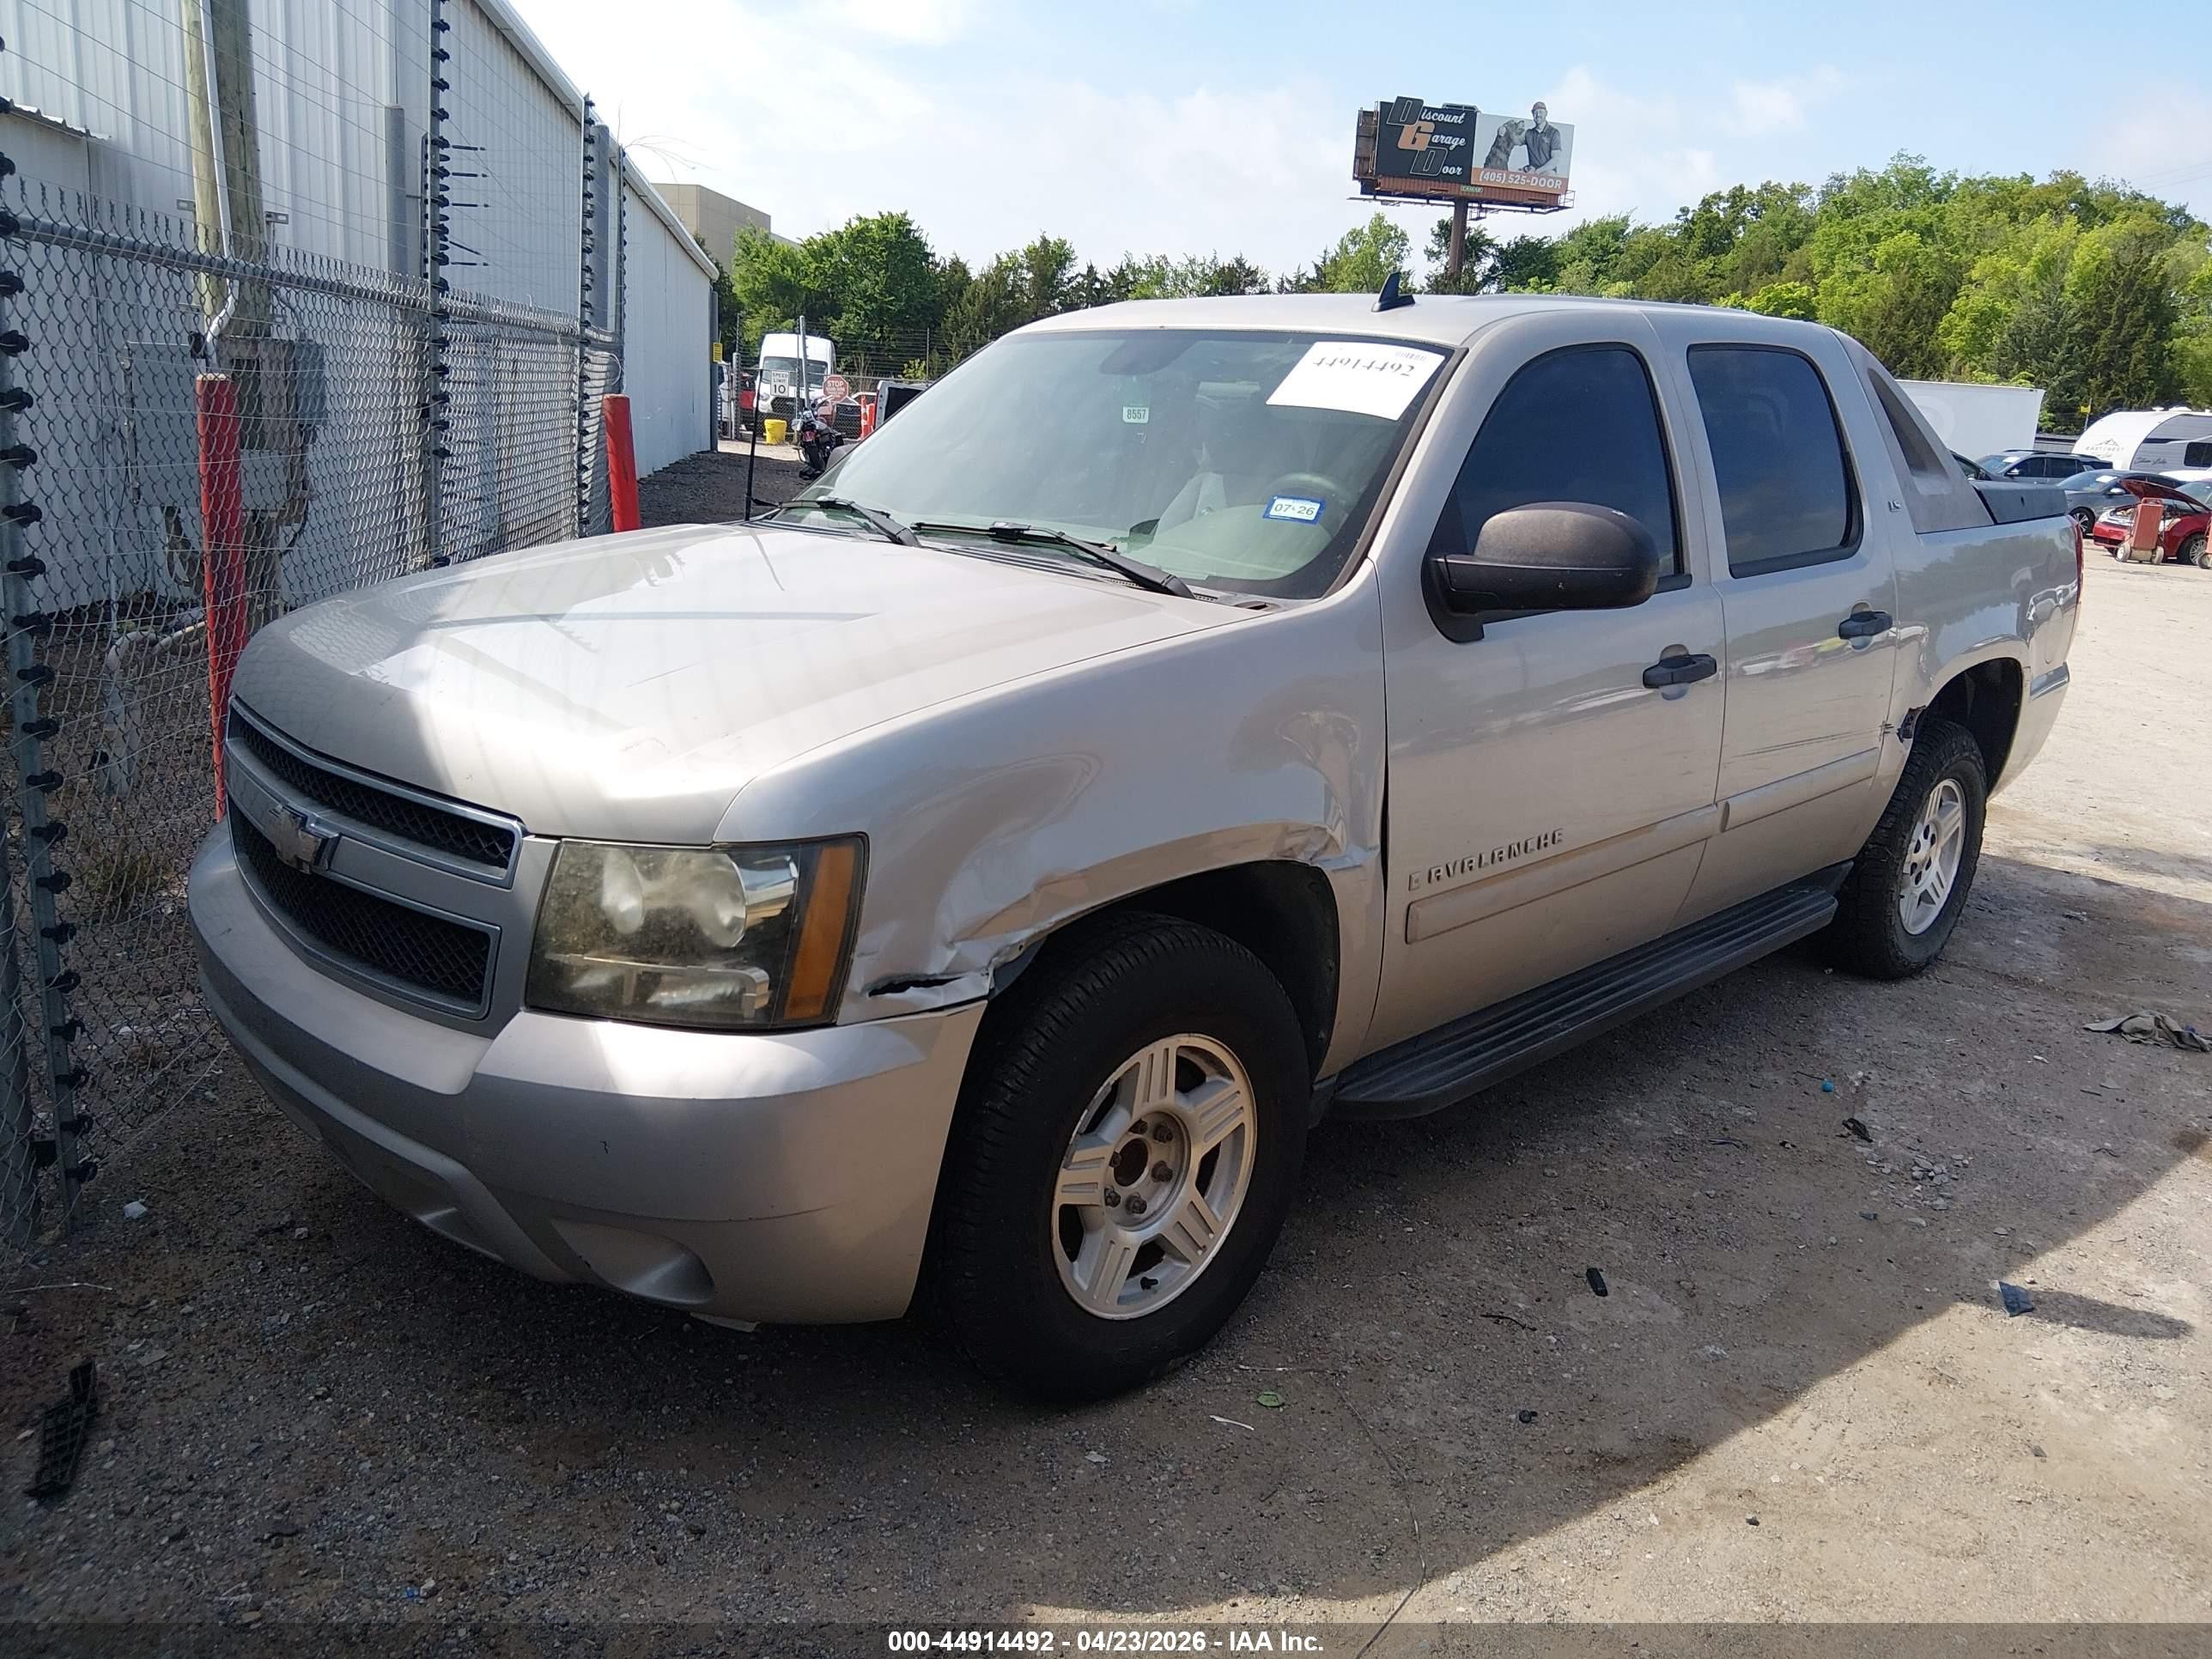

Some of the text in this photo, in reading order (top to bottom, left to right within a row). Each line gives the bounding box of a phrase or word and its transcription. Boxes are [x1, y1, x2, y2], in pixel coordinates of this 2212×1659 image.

[1386, 96, 1466, 126] Discount
[1398, 121, 1467, 151] Garage
[1409, 146, 1463, 177] Door
[1479, 170, 1563, 189] (405) 525-DOOR
[774, 384, 787, 394] 10
[1127, 409, 1146, 420] 8557
[1427, 827, 1565, 884] AVALANCHE
